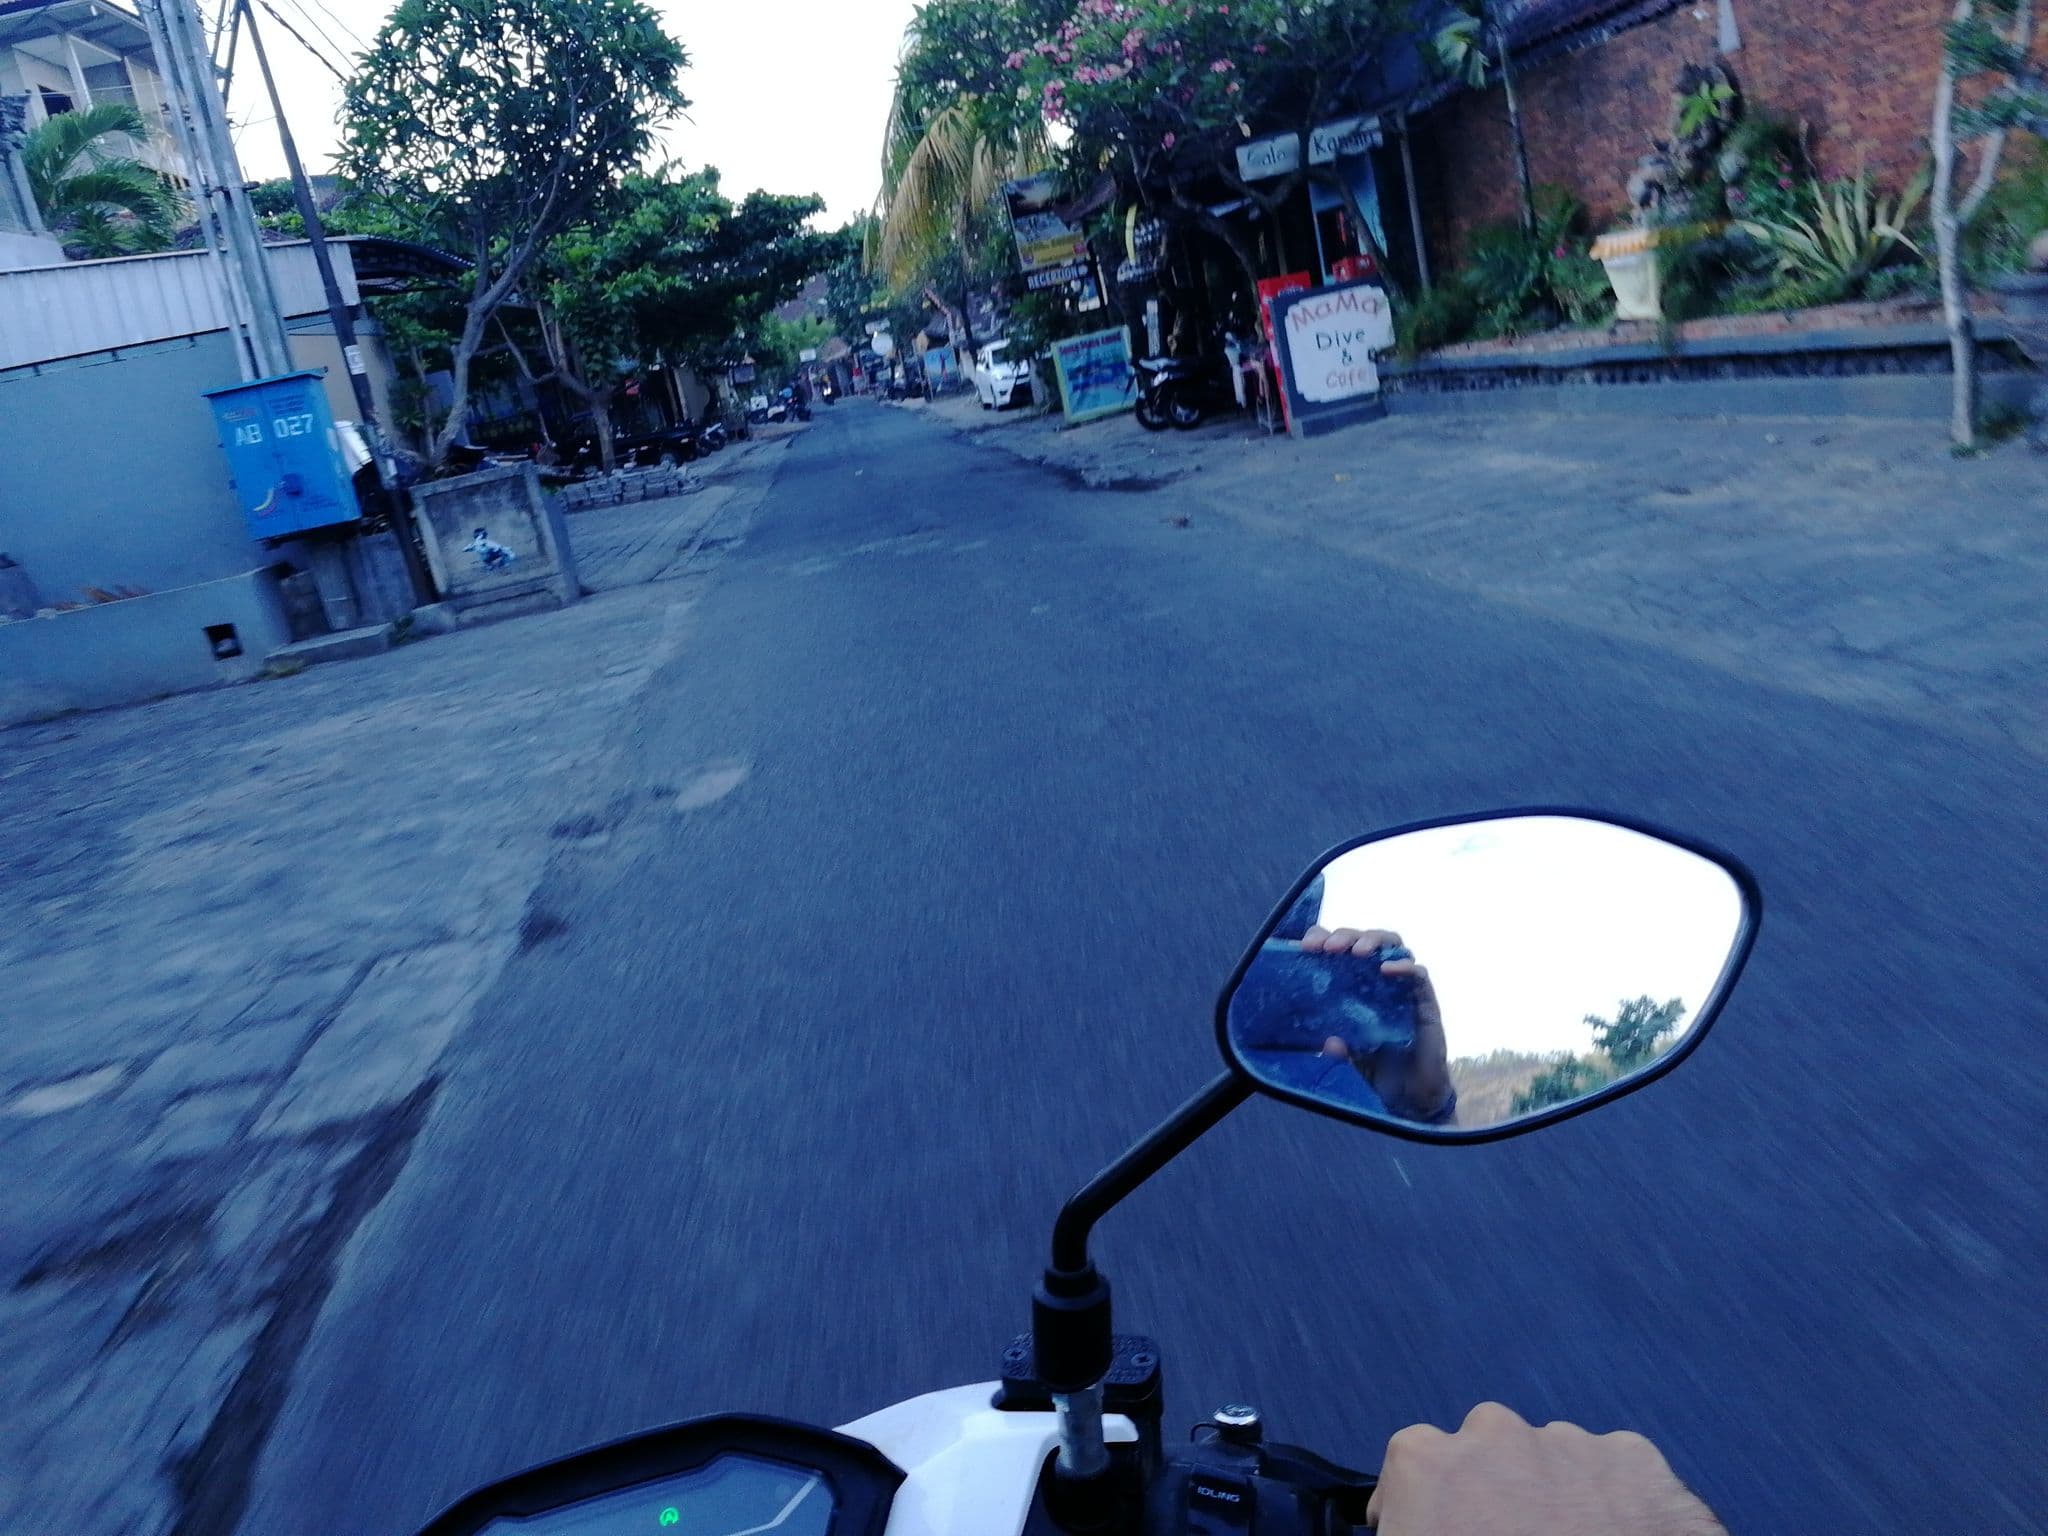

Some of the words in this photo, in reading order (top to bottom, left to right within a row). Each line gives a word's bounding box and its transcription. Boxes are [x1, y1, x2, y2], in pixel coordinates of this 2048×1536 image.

[235, 422, 263, 447] AB
[272, 413, 314, 438] 027
[1197, 1485, 1240, 1503] IDLING
